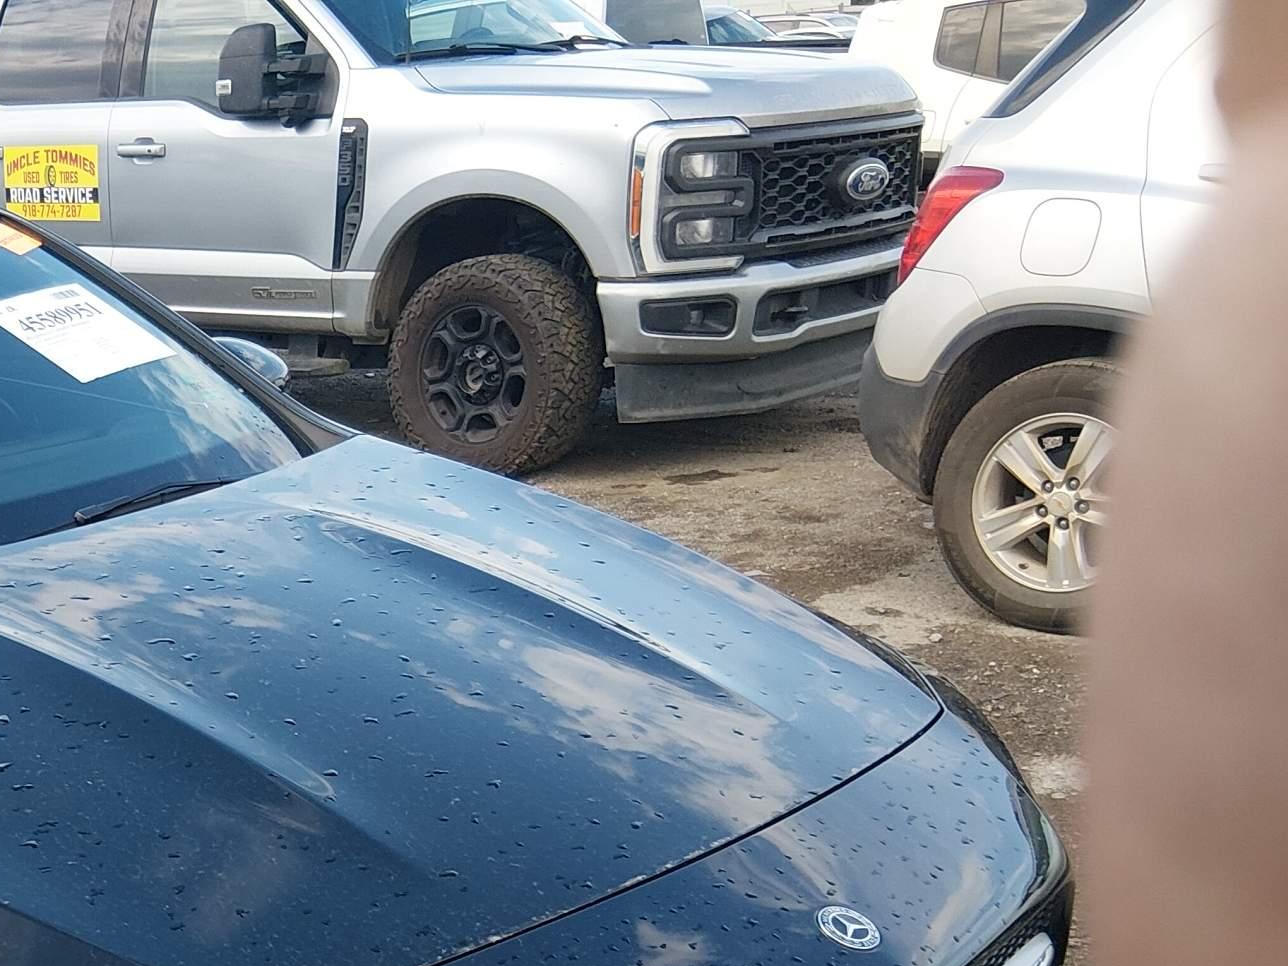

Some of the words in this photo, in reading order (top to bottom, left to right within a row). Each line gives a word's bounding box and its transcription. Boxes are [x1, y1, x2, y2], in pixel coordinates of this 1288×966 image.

[6, 150, 40, 176] UNCLE
[44, 149, 96, 176] TOMMIES
[23, 171, 40, 183] USED
[59, 171, 78, 183] TIRES
[10, 187, 40, 203] ROAD
[43, 187, 93, 203] SERVICE
[22, 204, 82, 217] 918-774-7287
[18, 302, 103, 332] 45589951
